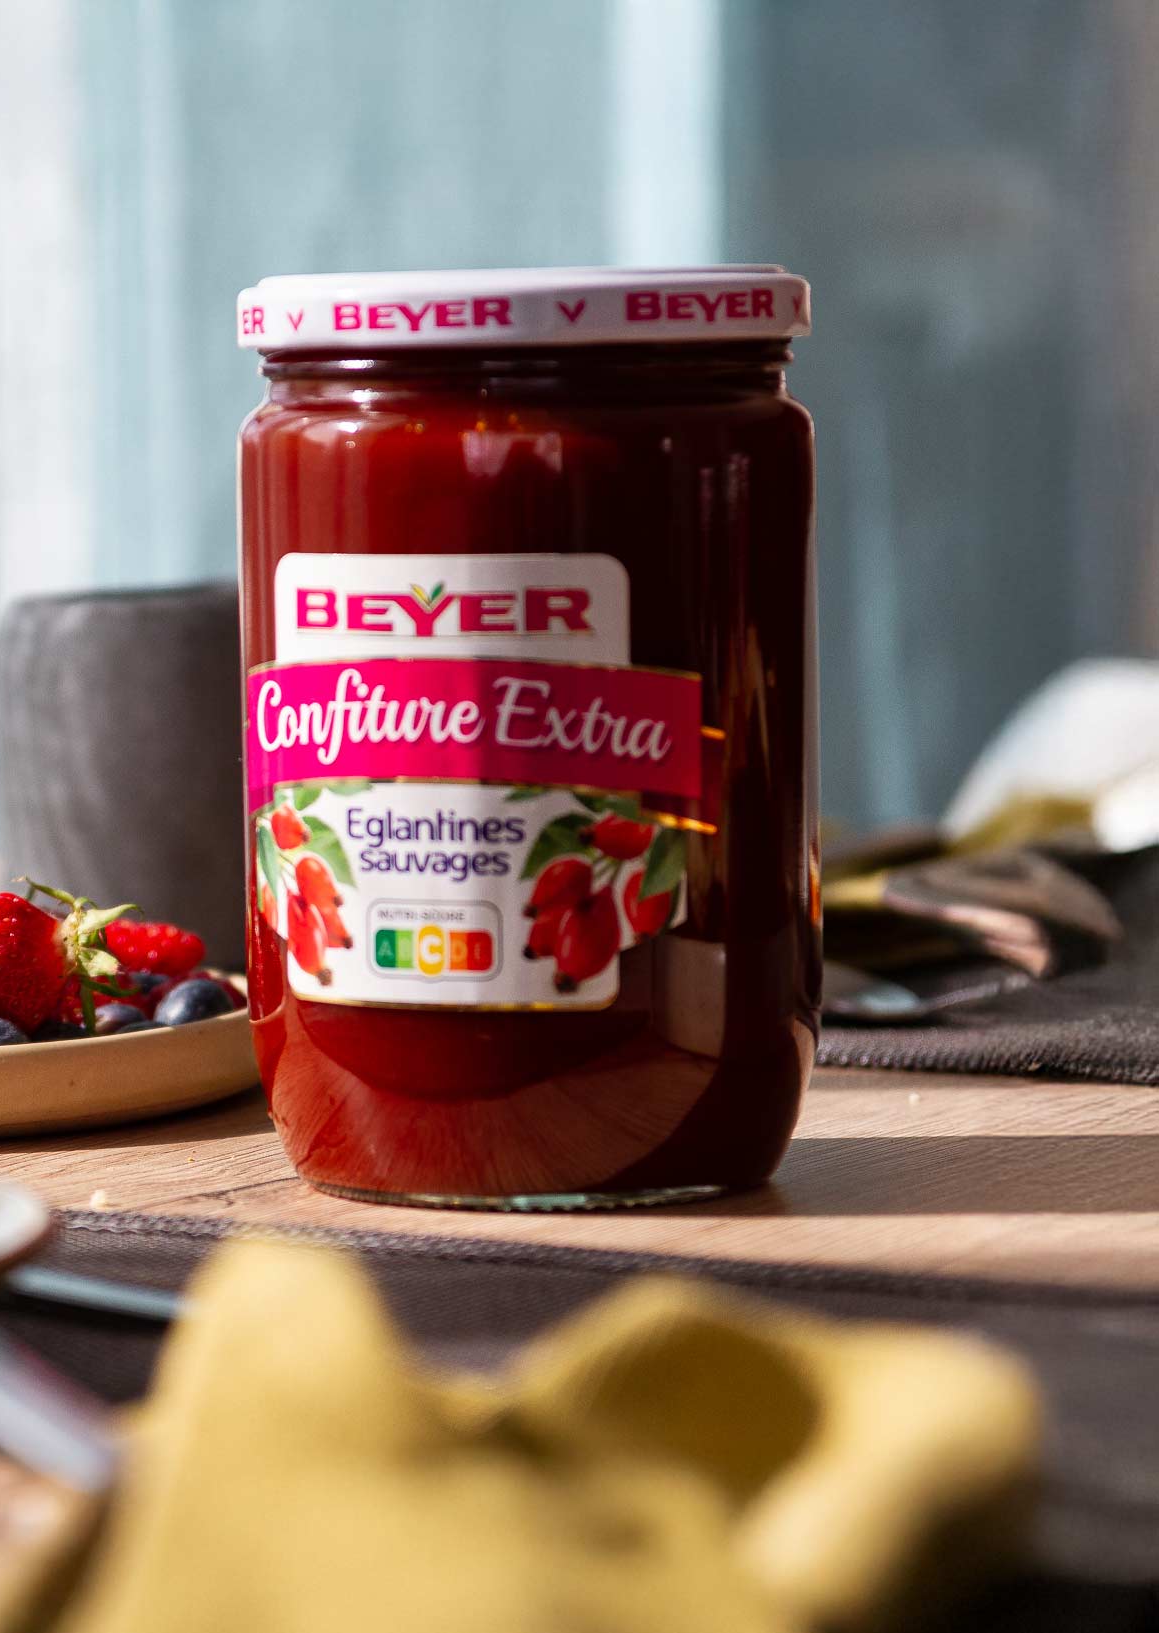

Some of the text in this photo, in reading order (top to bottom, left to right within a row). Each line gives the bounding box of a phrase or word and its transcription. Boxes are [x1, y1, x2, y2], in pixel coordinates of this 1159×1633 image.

[333, 297, 512, 333] BEYER
[625, 288, 775, 322] BEYER
[296, 585, 595, 637] BEYER
[256, 669, 671, 765] Confiture Extra
[348, 808, 525, 848] Eglantines
[360, 847, 511, 880] sauvages
[420, 935, 442, 965] C
